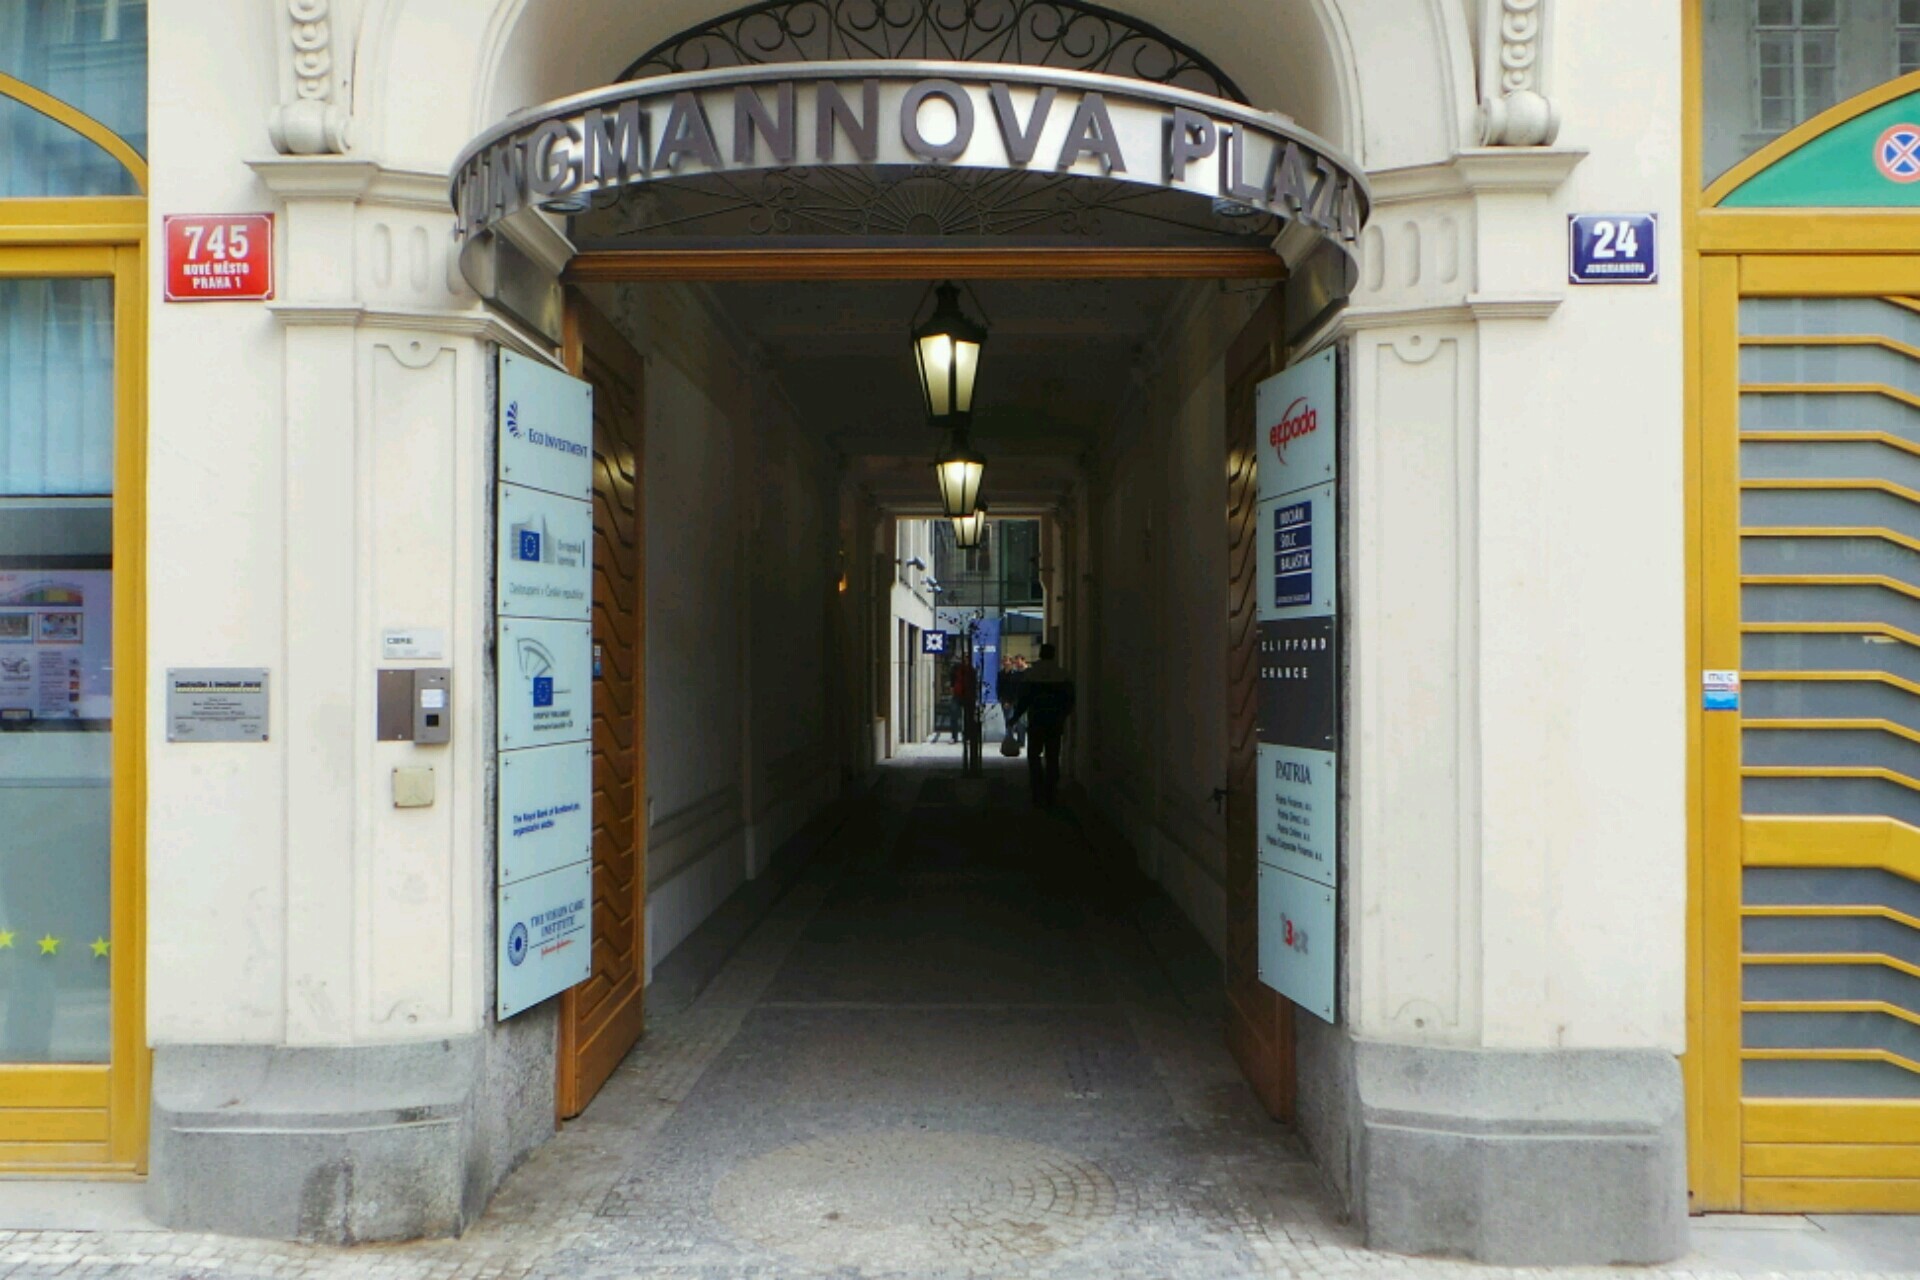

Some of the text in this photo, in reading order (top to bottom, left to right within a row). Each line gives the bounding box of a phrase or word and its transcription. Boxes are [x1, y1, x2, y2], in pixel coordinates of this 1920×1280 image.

[1171, 106, 1361, 241] PLAZA
[184, 225, 249, 260] 745
[1593, 220, 1638, 258] 24
[183, 261, 250, 275] NOVÉ MĚSTO
[192, 277, 241, 289] PRAHA 1
[1262, 637, 1326, 652] CLIFFORD
[1262, 667, 1308, 679] CHANCE
[1275, 760, 1312, 785] PATRIA
